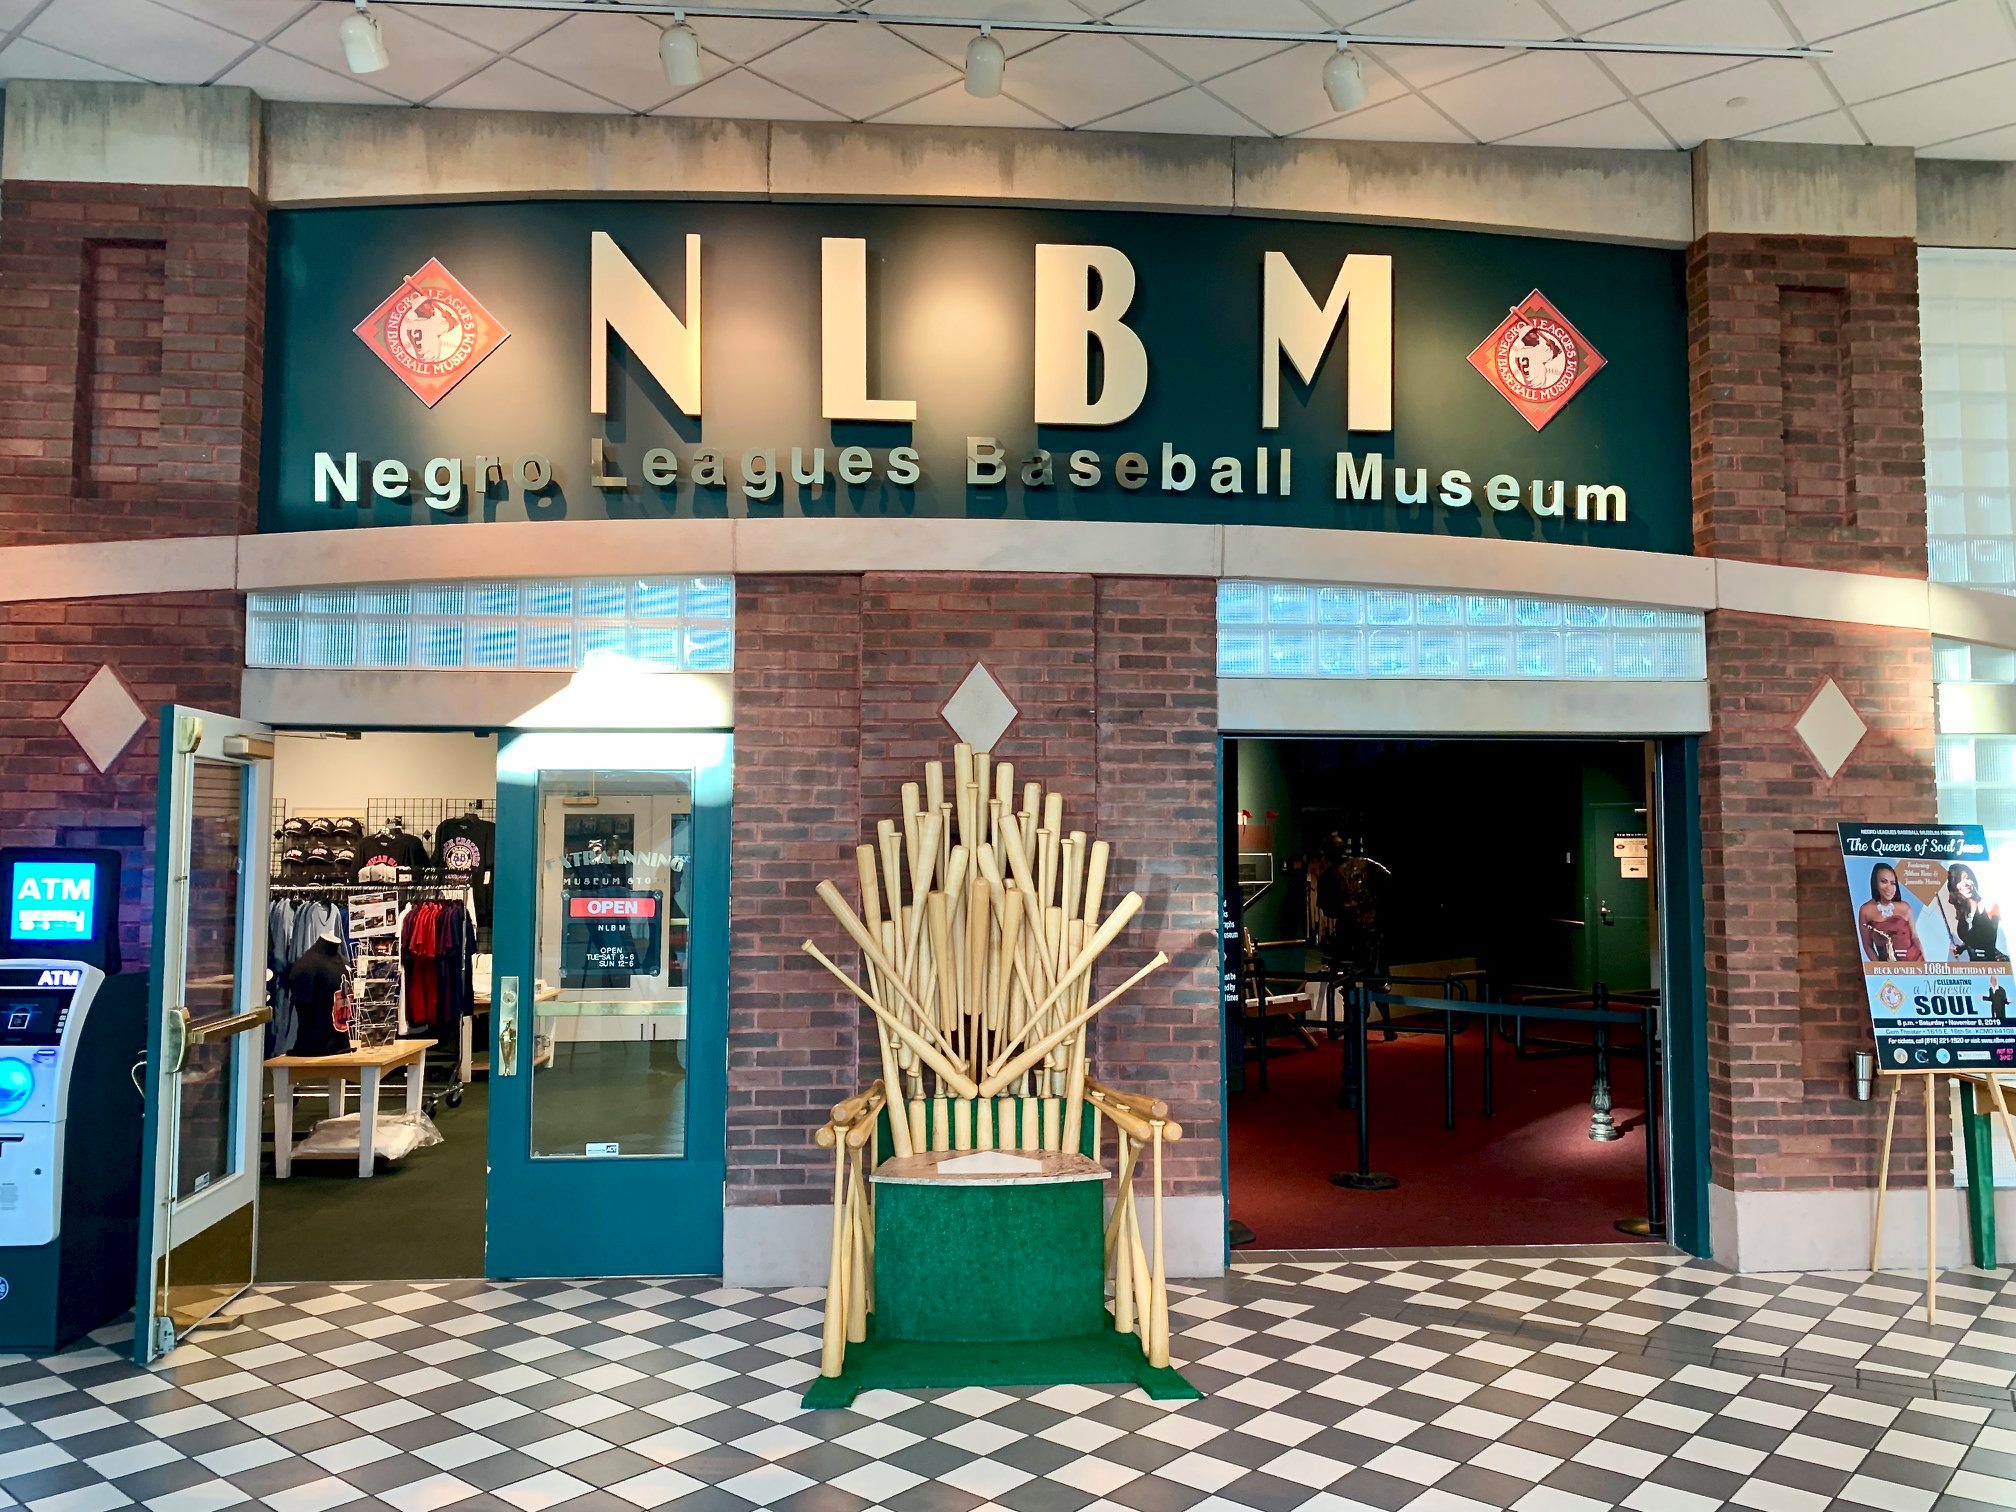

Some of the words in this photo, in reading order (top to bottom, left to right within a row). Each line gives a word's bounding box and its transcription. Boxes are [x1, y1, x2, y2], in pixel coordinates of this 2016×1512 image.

[388, 292, 423, 330] NEGRO
[1499, 321, 1527, 358] NEGRO
[1532, 319, 1577, 358] LEAGUES
[387, 332, 432, 375] BASEBALL
[433, 332, 475, 375] MUSEUM
[1498, 359, 1539, 400] BASEBALL
[1540, 360, 1577, 400] MUSEUM
[314, 452, 552, 511] Negro
[590, 438, 920, 499] Leagues
[966, 436, 1291, 496] Baseball
[1336, 452, 1627, 522] Museum
[1846, 838, 1868, 852] The
[1871, 838, 1911, 856] Queens
[1914, 838, 1928, 856] of
[1930, 839, 1955, 852] Soul
[18, 878, 91, 900] ATM
[563, 878, 621, 886] MUSEUM
[587, 900, 638, 914] OPEN
[38, 970, 81, 986] ATM
[1874, 966, 1893, 974] BUCK
[1924, 962, 1950, 975] 108th
[1913, 985, 1920, 994] a
[1924, 980, 1971, 997] Majestic
[1914, 996, 1978, 1015] SOUL
